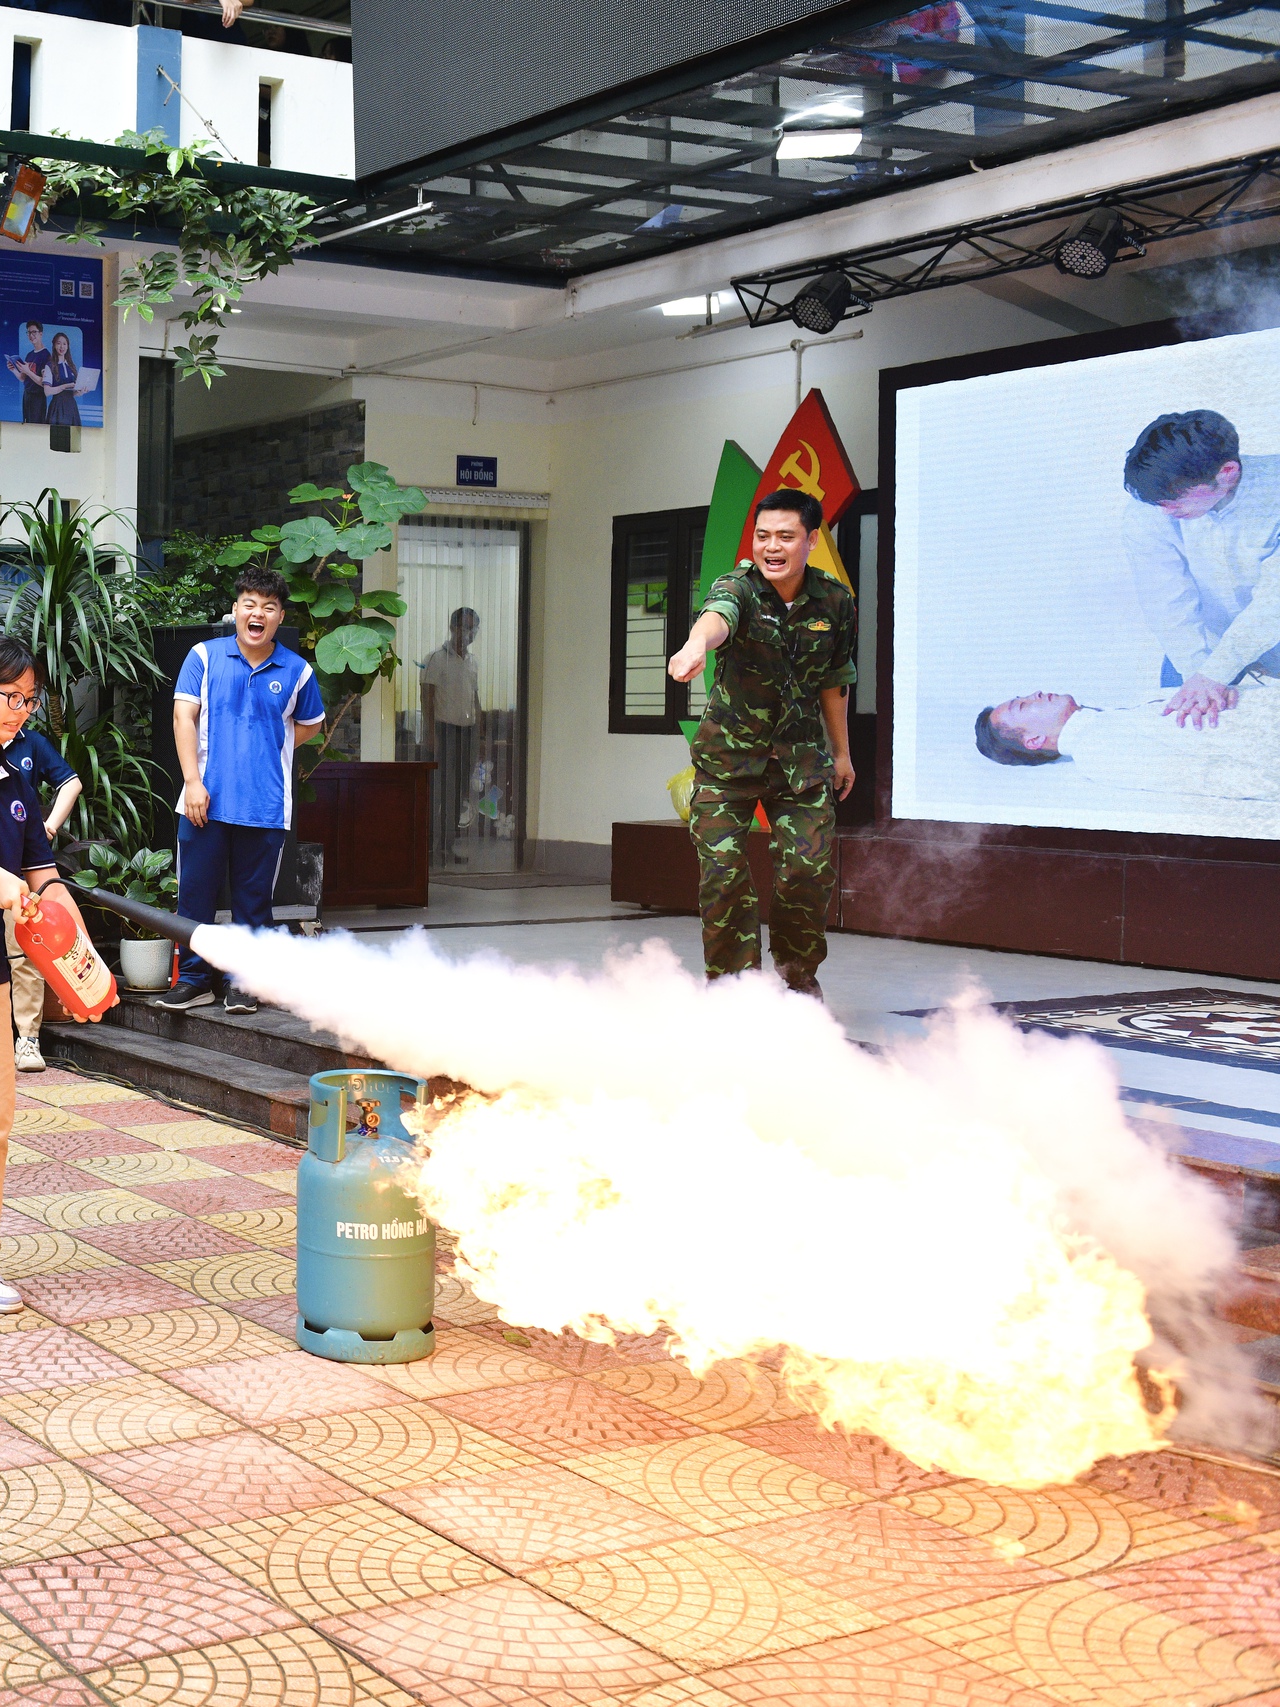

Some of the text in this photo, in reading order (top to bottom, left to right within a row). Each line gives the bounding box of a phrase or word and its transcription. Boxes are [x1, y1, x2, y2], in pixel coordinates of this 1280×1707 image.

[460, 468, 494, 482] HỘI ĐỒNG
[336, 1222, 378, 1240] PETRO
[381, 1217, 414, 1240] HỒNG
